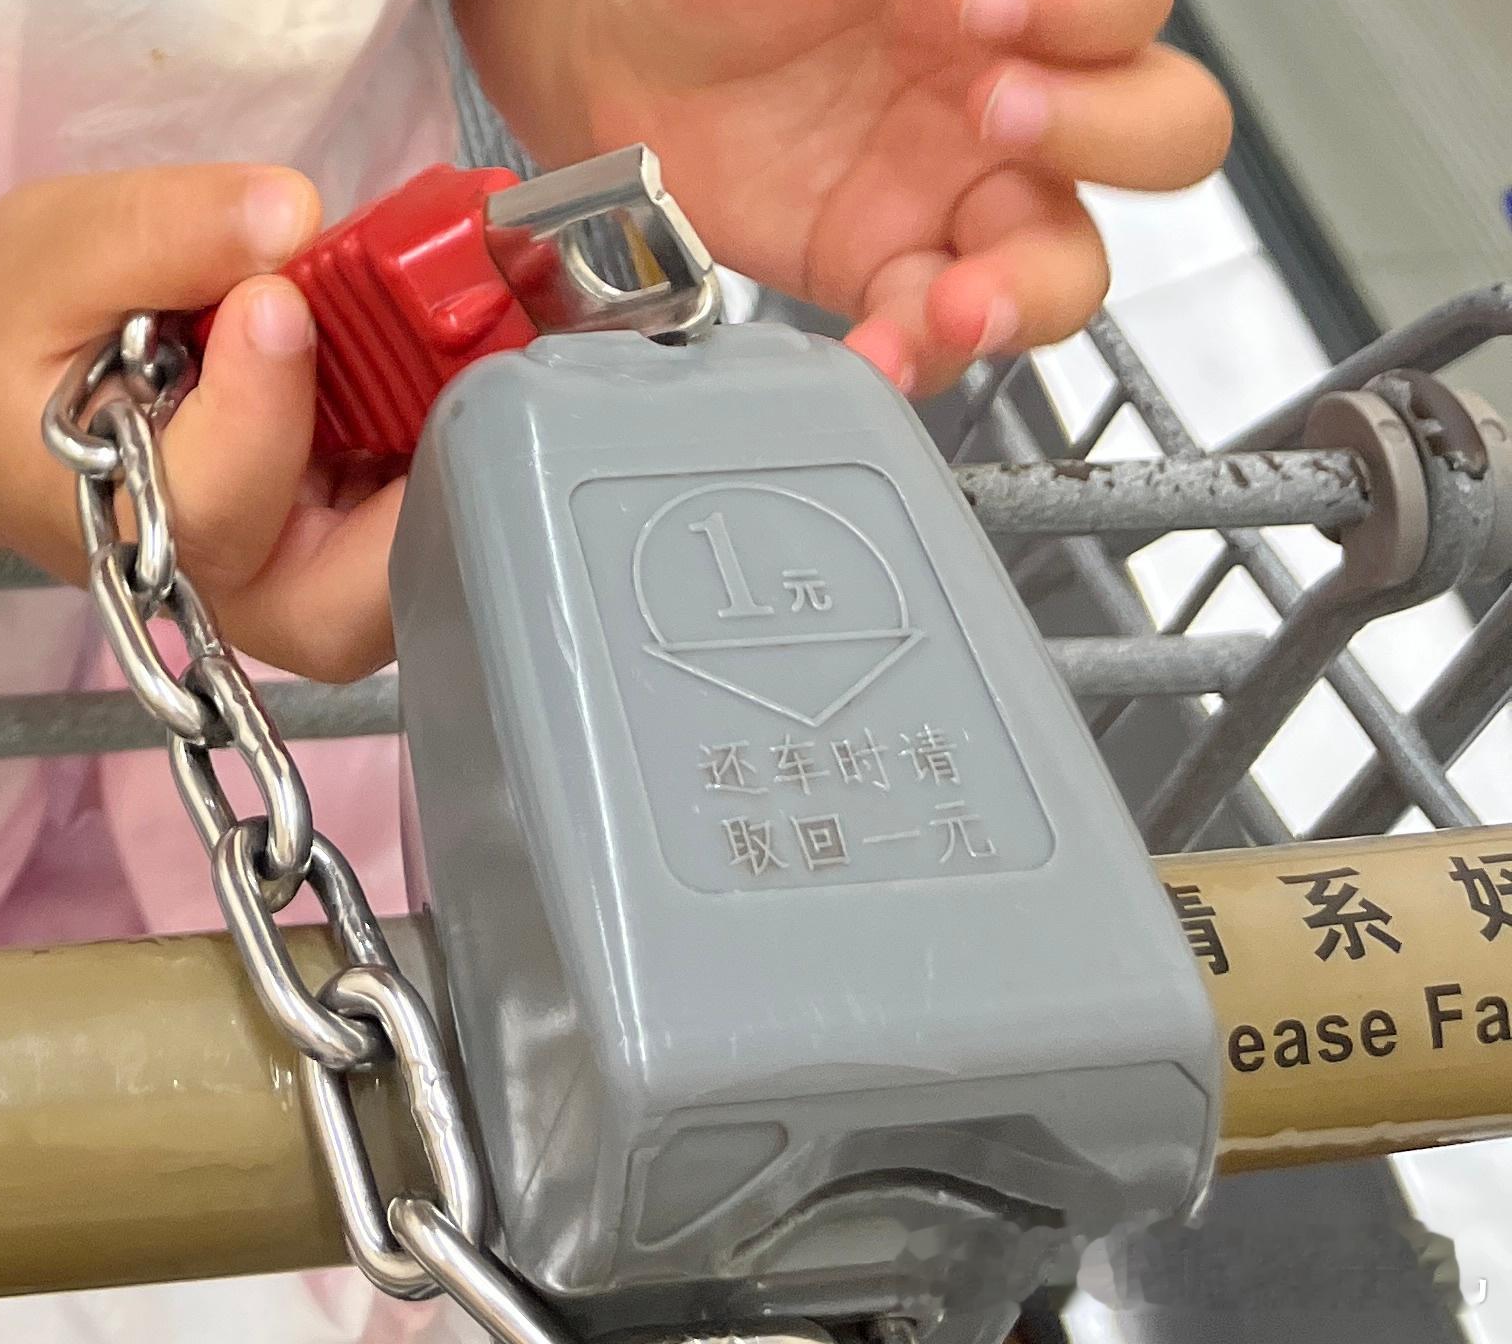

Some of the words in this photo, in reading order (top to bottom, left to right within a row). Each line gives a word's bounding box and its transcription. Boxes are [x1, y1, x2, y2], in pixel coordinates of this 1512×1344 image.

[699, 724, 962, 796] 还车时请
[722, 800, 999, 876] 取回一元
[1228, 1009, 1397, 1073] ease
[1424, 983, 1512, 1050] Fa
